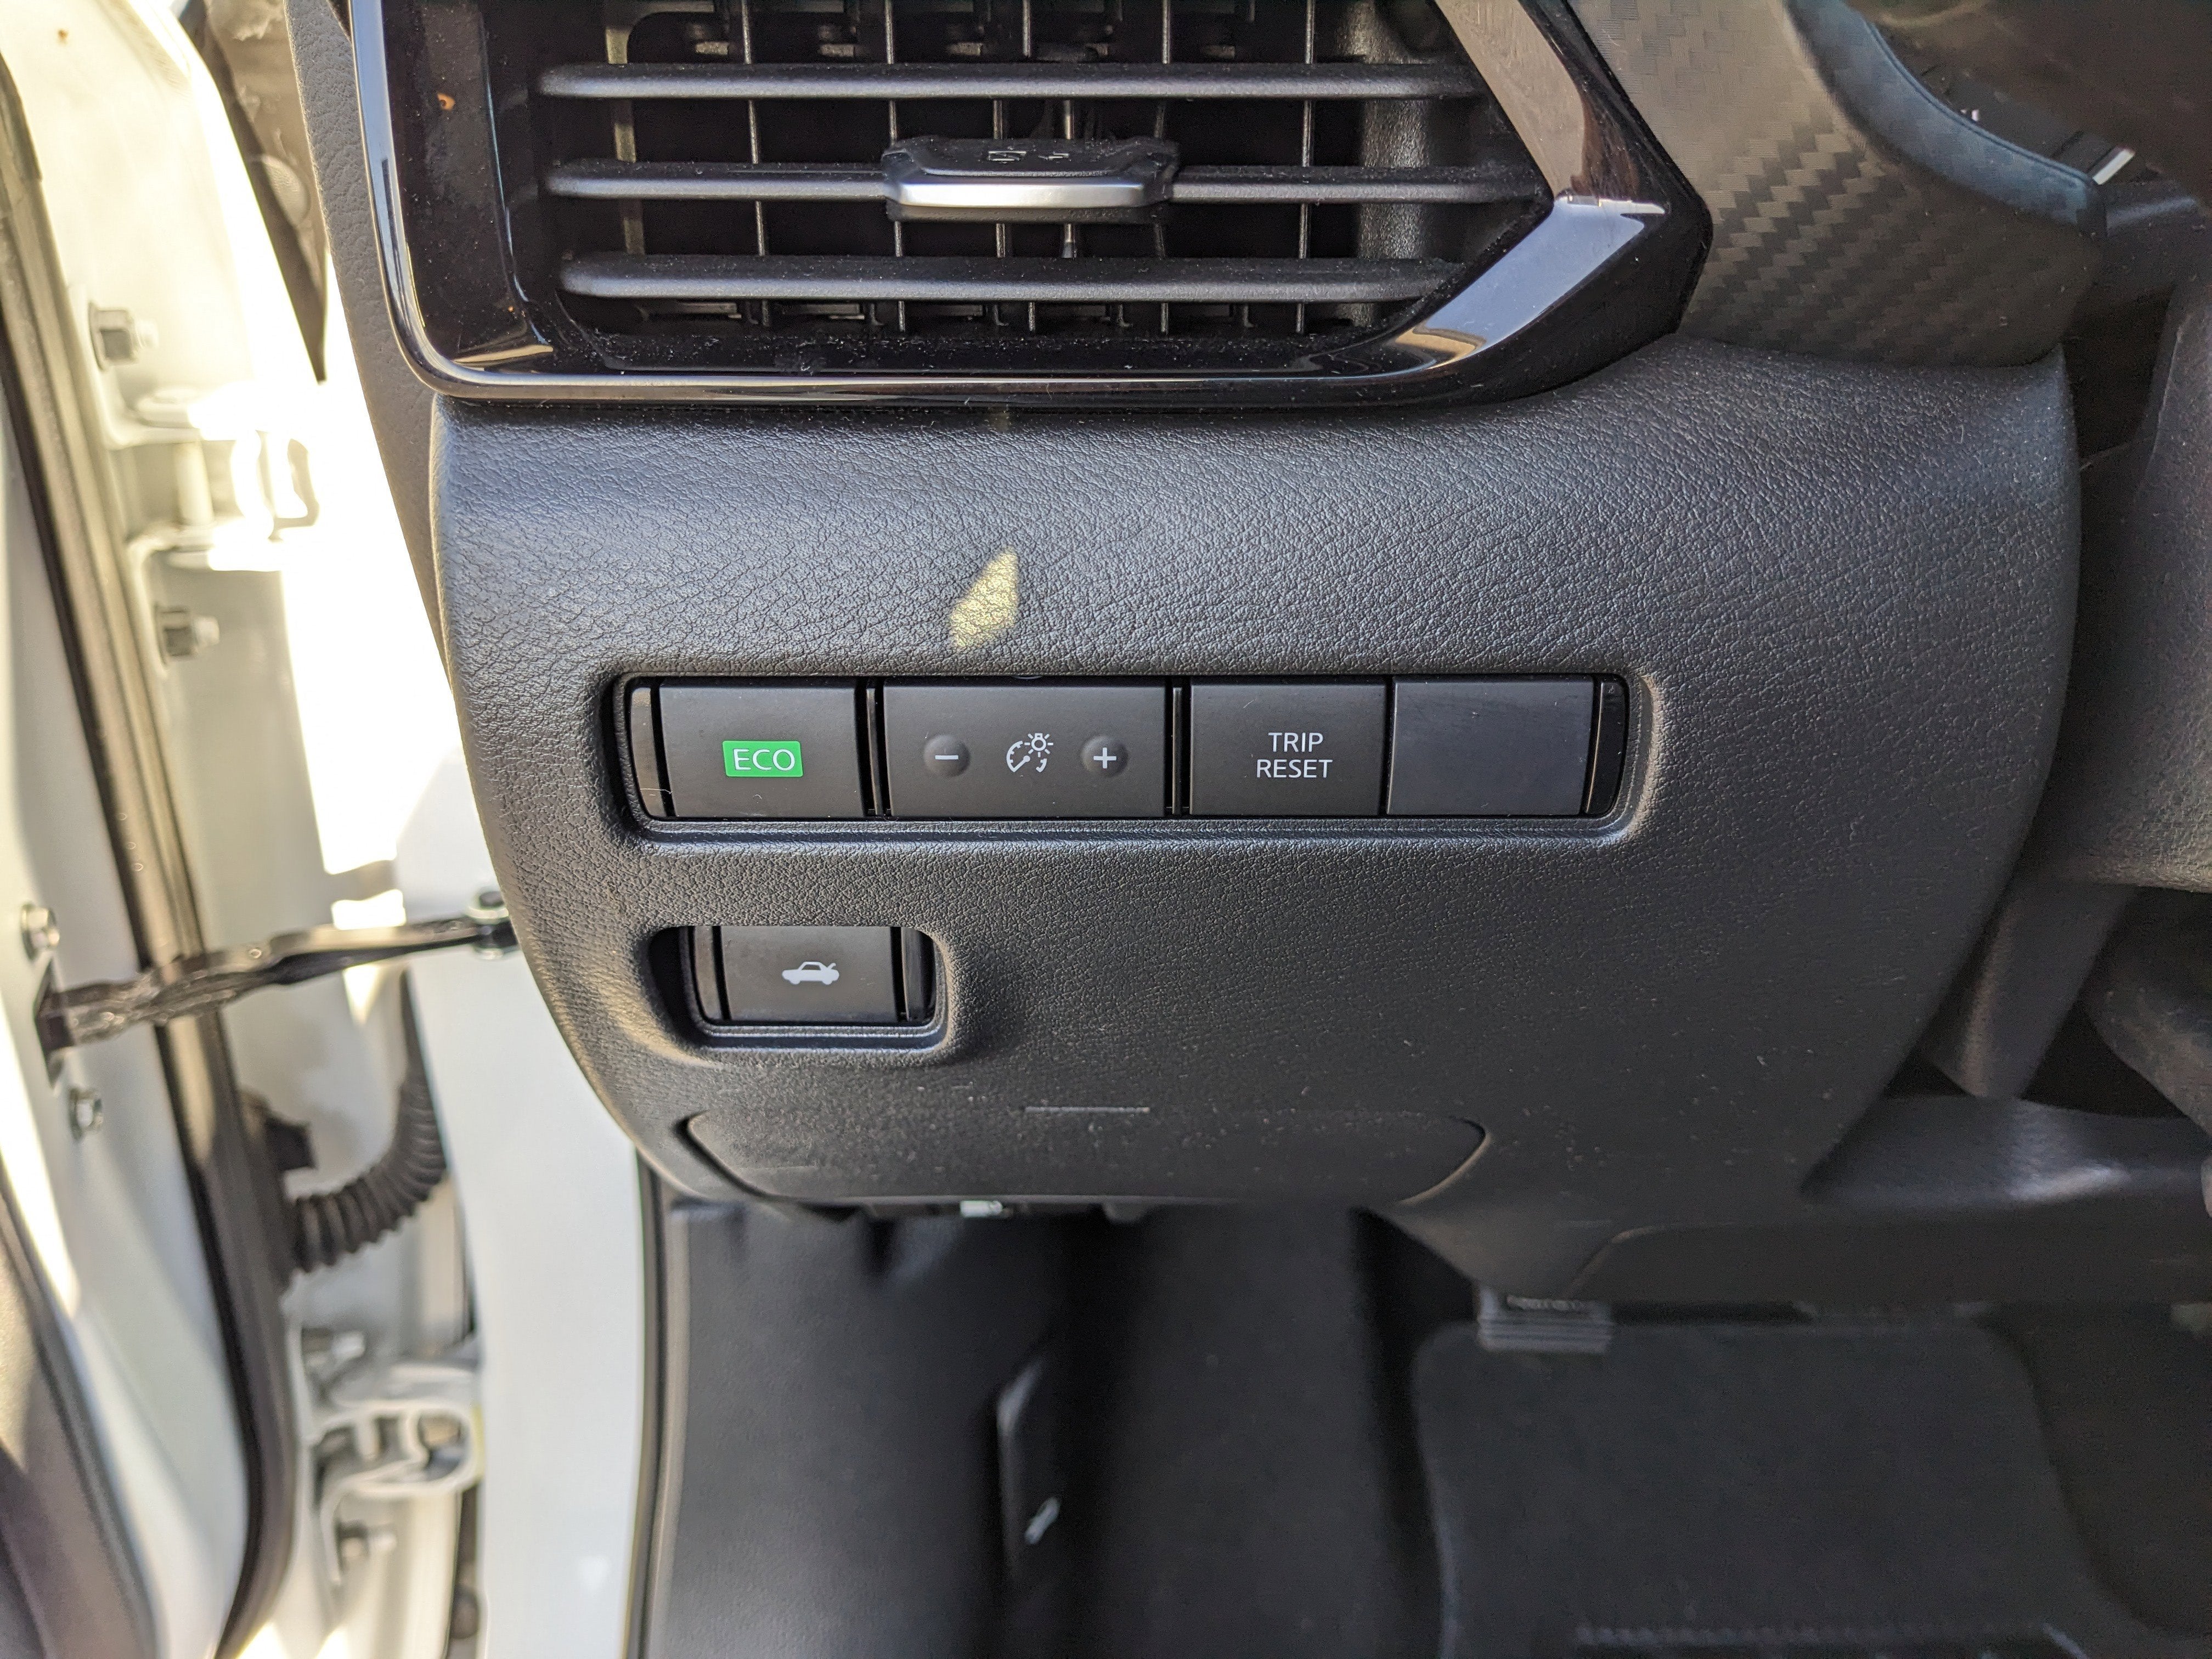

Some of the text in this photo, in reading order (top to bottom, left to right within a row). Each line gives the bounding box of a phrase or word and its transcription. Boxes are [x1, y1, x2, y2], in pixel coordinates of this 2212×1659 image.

[1268, 732, 1324, 753] TRIP
[733, 748, 795, 771] ECO
[1256, 759, 1334, 778] RESET
